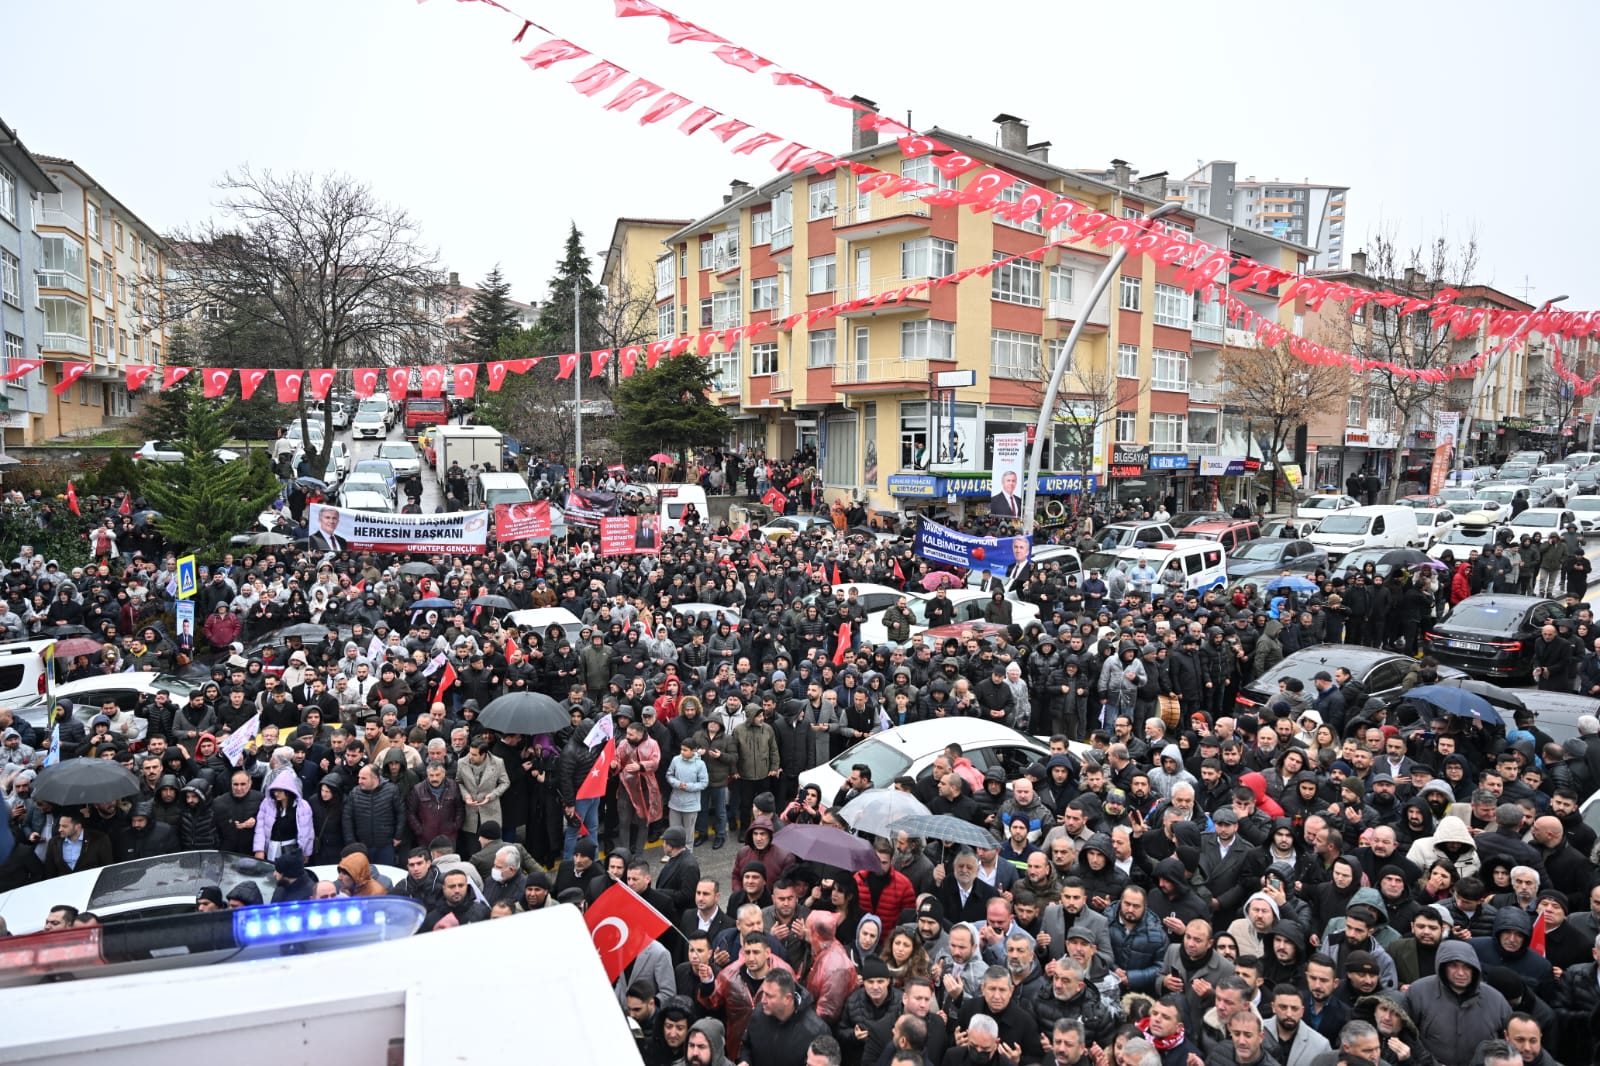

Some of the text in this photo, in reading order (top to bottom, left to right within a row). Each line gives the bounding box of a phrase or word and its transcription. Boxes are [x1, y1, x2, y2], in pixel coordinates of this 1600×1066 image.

[1114, 452, 1149, 464] BİLGİSAYAR
[419, 516, 464, 526] BAŞKANI
[353, 526, 464, 540] HERKESİN BAŞKANI
[446, 545, 477, 554] GENÇLİK
[922, 534, 968, 554] KALBİMİZE
